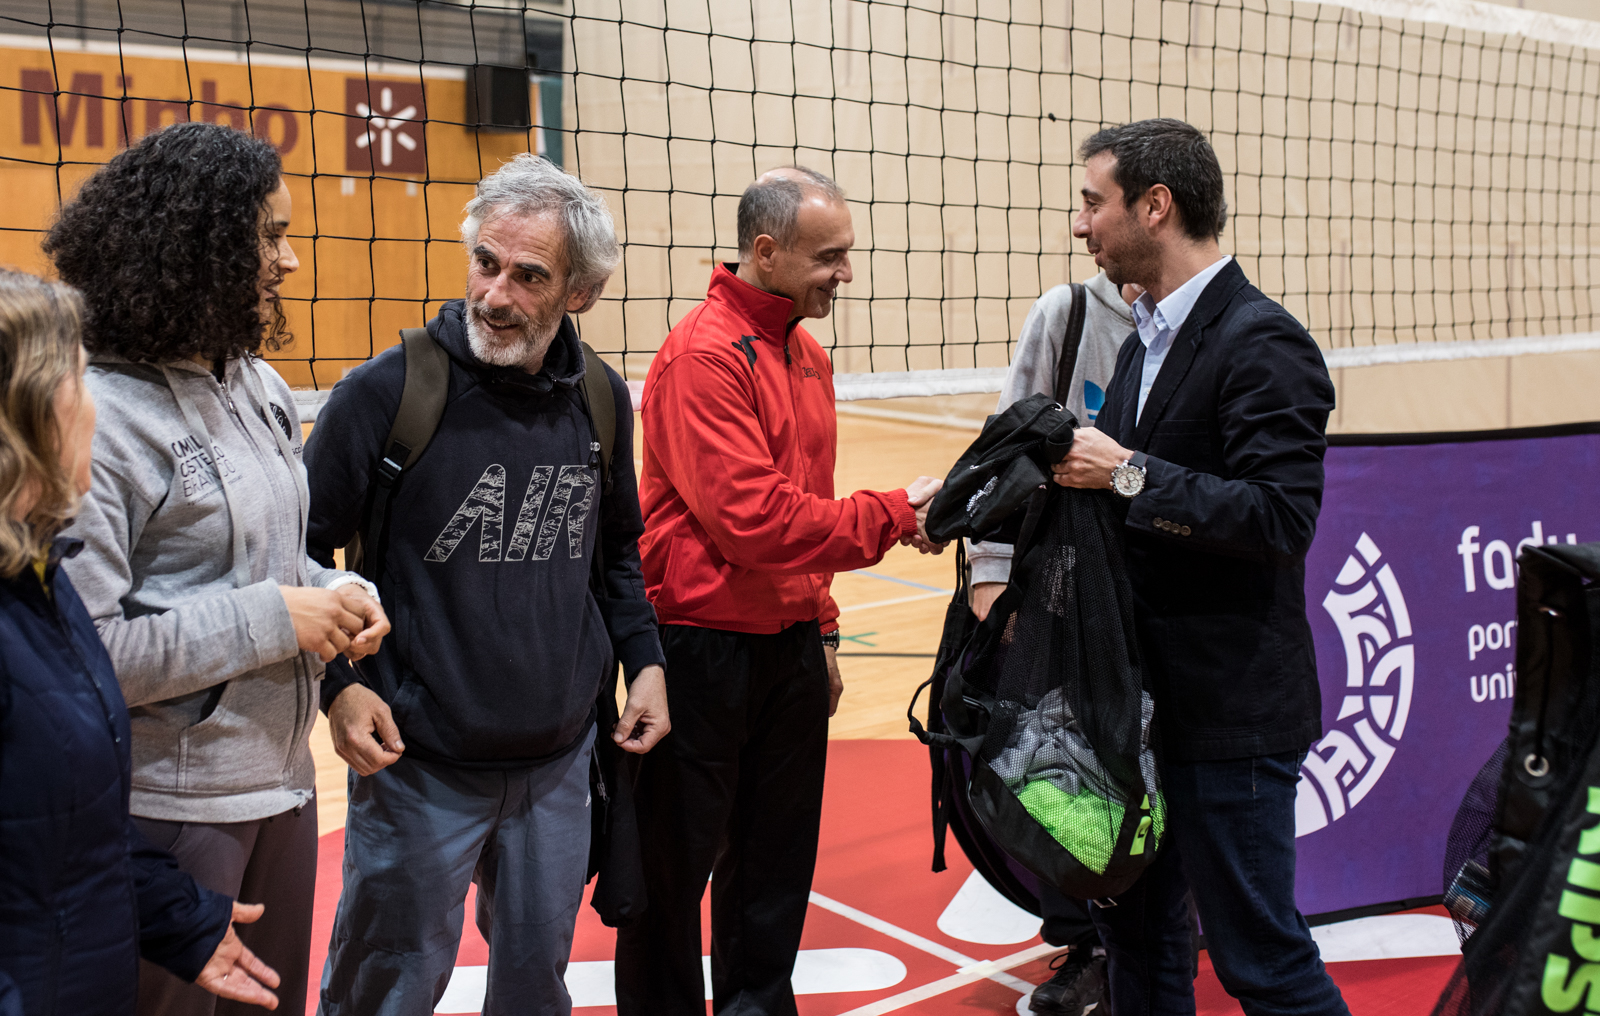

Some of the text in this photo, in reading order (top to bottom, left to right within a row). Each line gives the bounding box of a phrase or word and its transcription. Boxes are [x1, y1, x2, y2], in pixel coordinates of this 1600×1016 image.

[424, 463, 597, 562] AIR
[1468, 620, 1518, 661] por
[1470, 662, 1517, 702] uni
